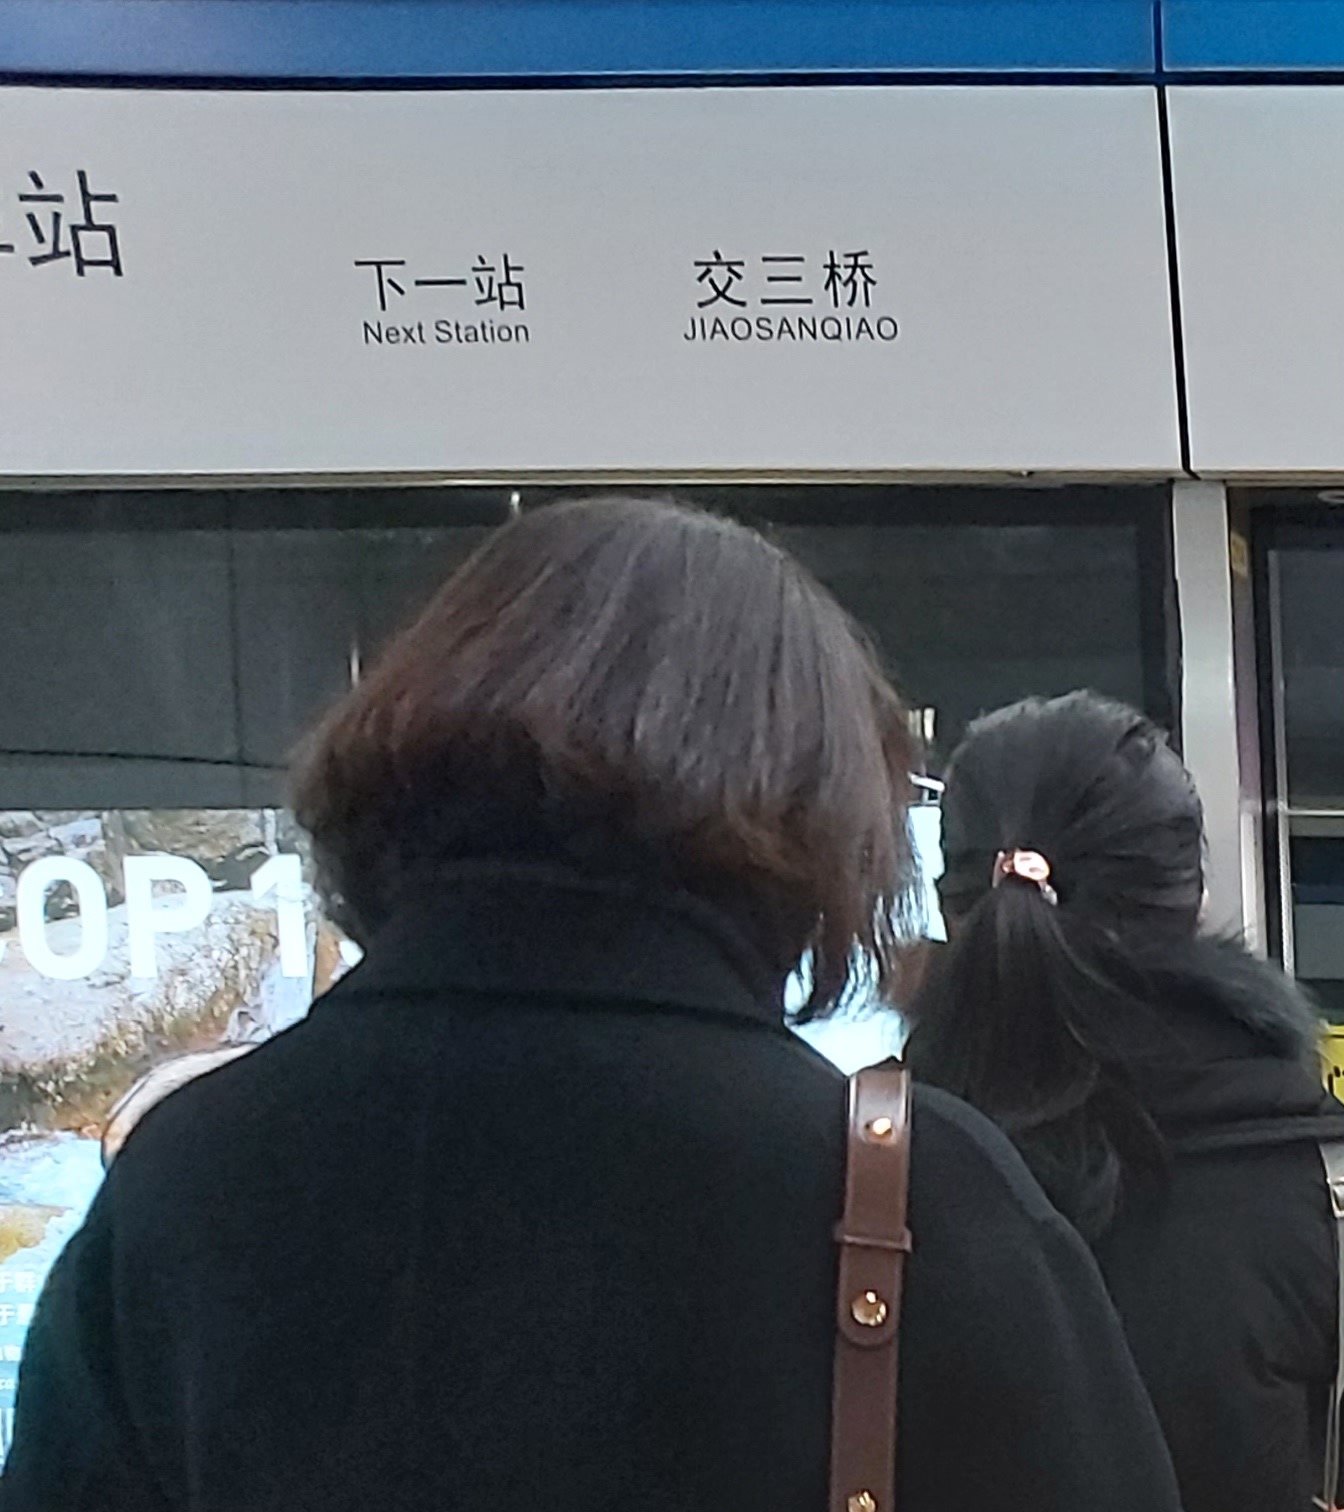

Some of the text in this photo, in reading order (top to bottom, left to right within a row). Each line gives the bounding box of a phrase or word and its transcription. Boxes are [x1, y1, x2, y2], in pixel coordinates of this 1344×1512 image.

[0, 168, 123, 277] 站
[354, 253, 526, 311] 下一站
[693, 249, 877, 308] 交三桥
[363, 319, 530, 346] Next Station
[683, 316, 898, 343] JIAOSANQIAO
[0, 853, 213, 979] OP
